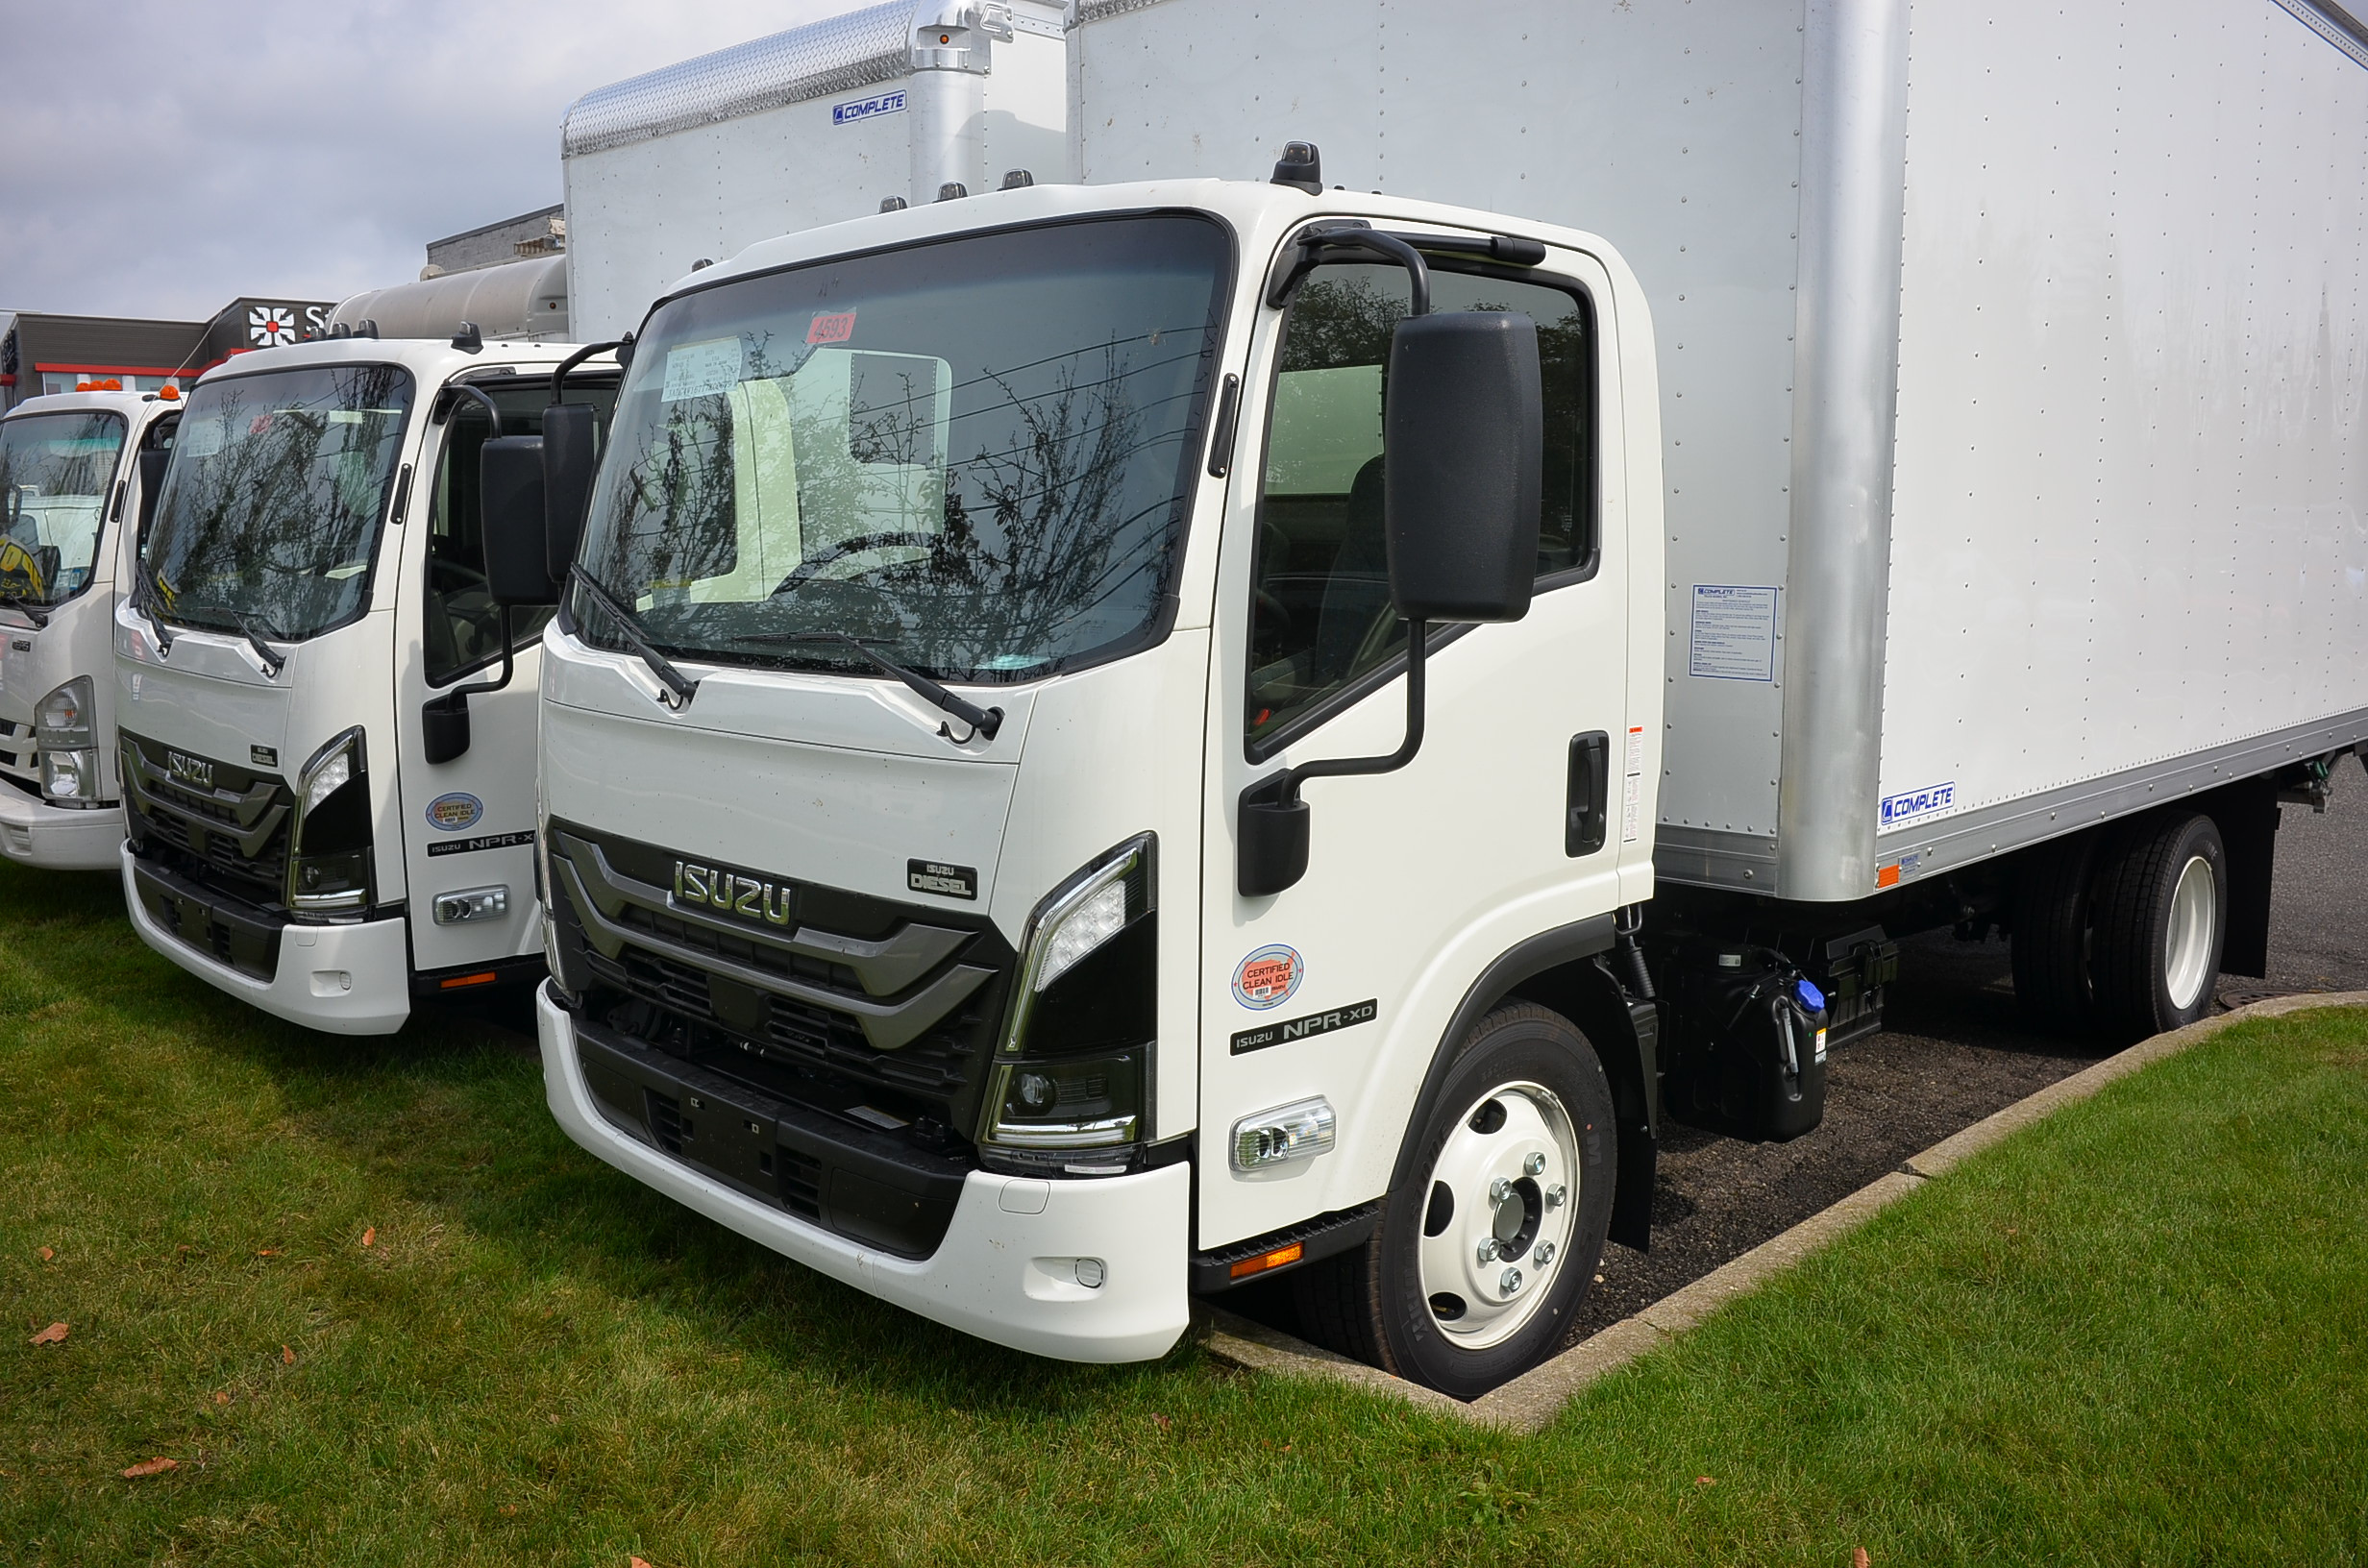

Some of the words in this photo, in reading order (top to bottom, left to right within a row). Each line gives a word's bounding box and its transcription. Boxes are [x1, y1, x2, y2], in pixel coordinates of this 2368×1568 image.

[845, 94, 905, 119] COMPLETE
[168, 751, 212, 788] ISUZU
[437, 803, 472, 813] CERTIFIED
[1894, 787, 1954, 818] COMPLETE
[432, 844, 461, 853] ISUZU
[468, 834, 534, 850] NPR-X
[926, 864, 954, 875] ISUZU
[675, 861, 791, 925] ISUZU
[910, 872, 972, 895] DIESEL
[1243, 977, 1272, 991] CLEAN
[1275, 971, 1294, 983] IDLE
[1246, 962, 1291, 978] CERTIFIED
[1236, 1031, 1273, 1048] ISUZU
[1284, 1005, 1373, 1041] NPR-XD
